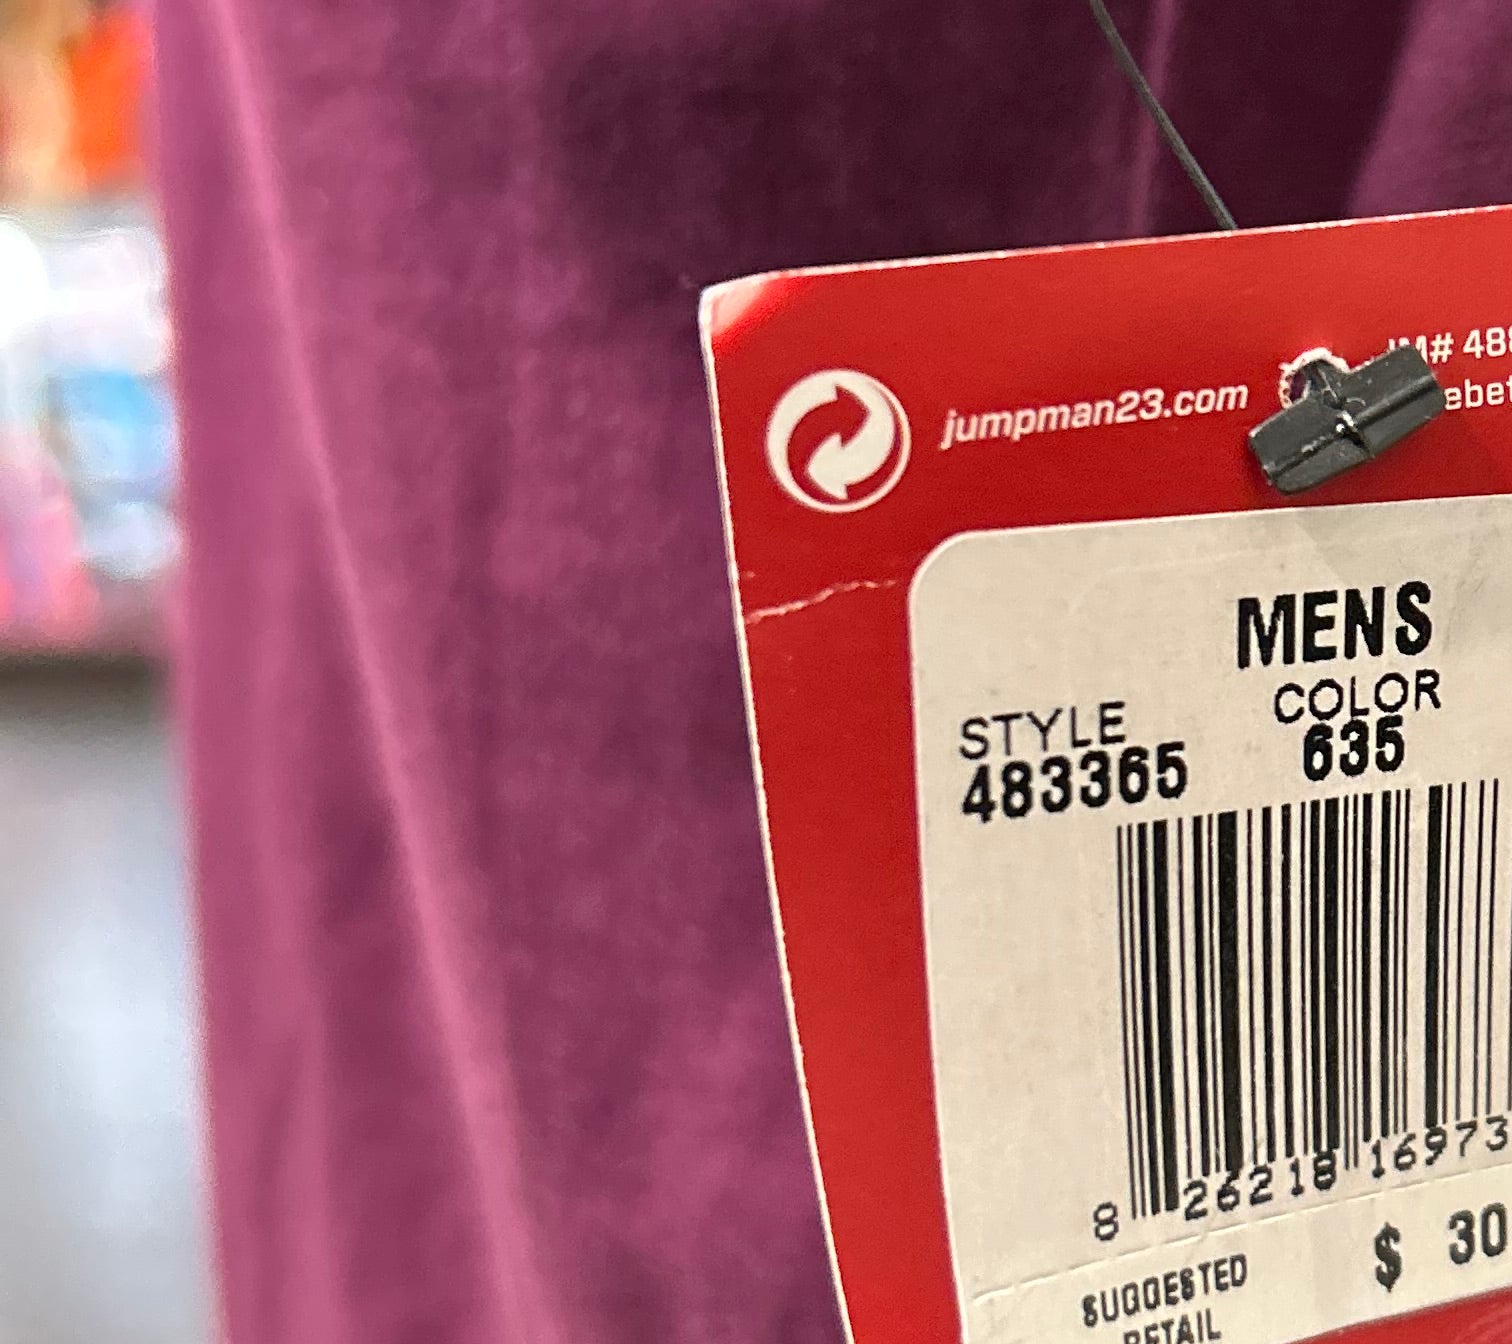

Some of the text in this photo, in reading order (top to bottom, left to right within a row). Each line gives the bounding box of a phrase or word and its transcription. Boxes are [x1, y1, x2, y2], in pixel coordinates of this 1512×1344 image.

[940, 384, 1249, 450] jumpman23.com
[1236, 581, 1432, 670] MENS
[958, 701, 1127, 761] STYLE
[1273, 669, 1441, 725] COLOR
[961, 741, 1189, 824] 483365
[1302, 715, 1405, 782] 635
[1092, 1201, 1119, 1242] 8
[1183, 1148, 1338, 1222] 26218
[1371, 1115, 1510, 1179] 16973
[1082, 1254, 1248, 1328] SUGGESTED
[1373, 1221, 1403, 1293] $
